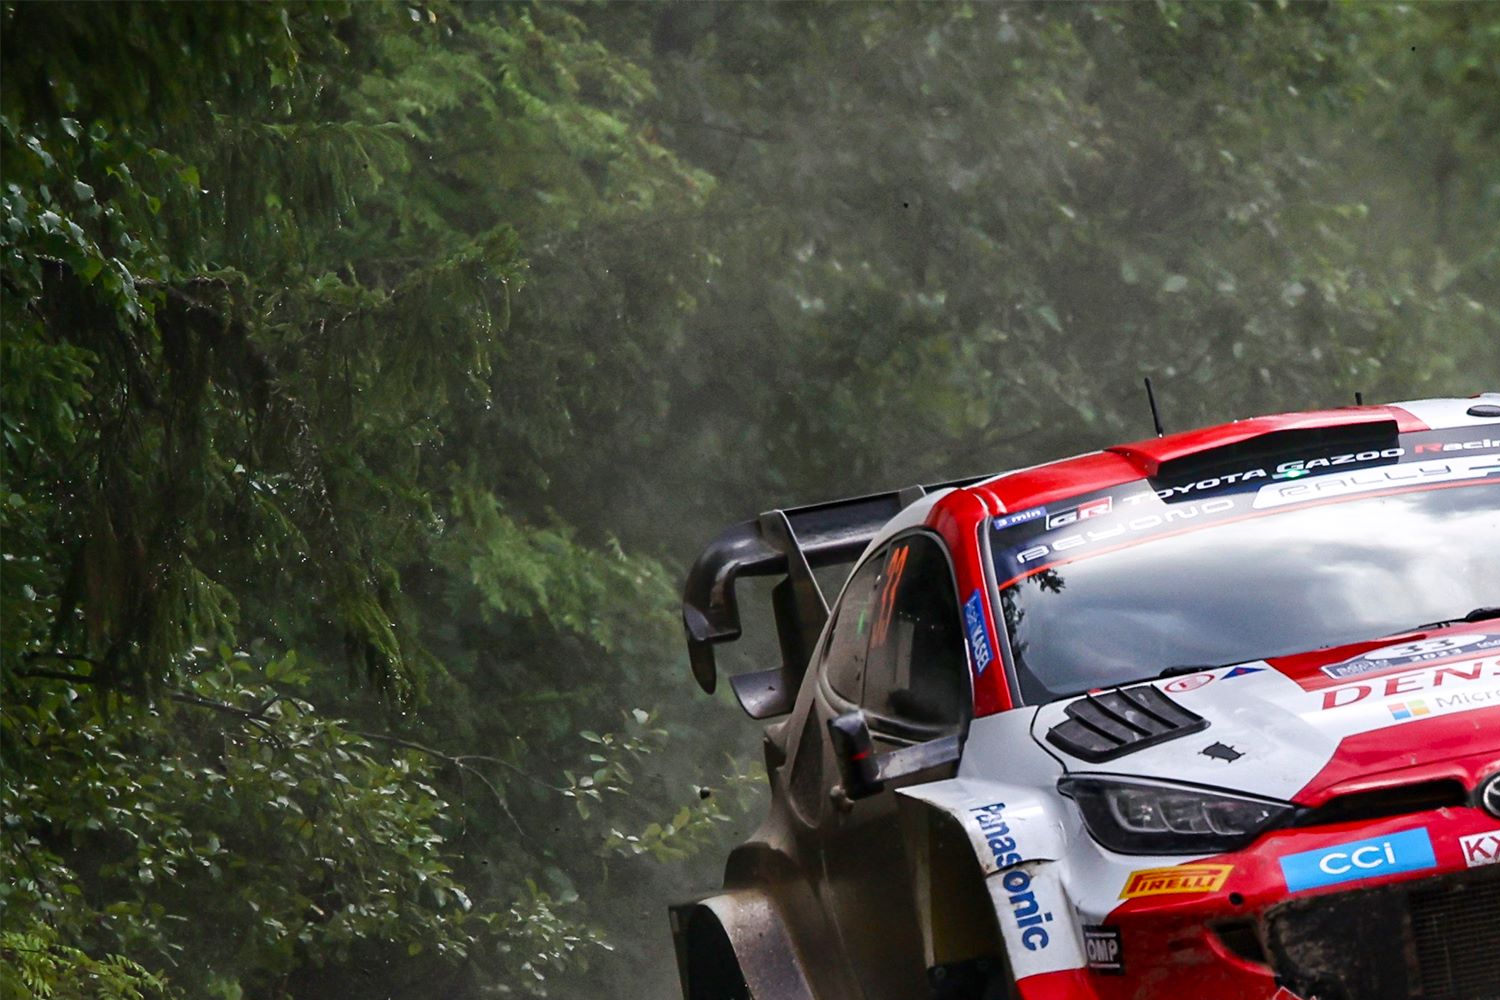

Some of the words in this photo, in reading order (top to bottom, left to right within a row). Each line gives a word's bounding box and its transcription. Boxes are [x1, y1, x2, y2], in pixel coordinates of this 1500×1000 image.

[1122, 468, 1268, 505] TOYOTA
[1274, 447, 1405, 475] GAZOO
[969, 802, 1054, 951] Panasonic
[1126, 868, 1222, 894] PIRELLI
[1086, 939, 1118, 962] OMP
